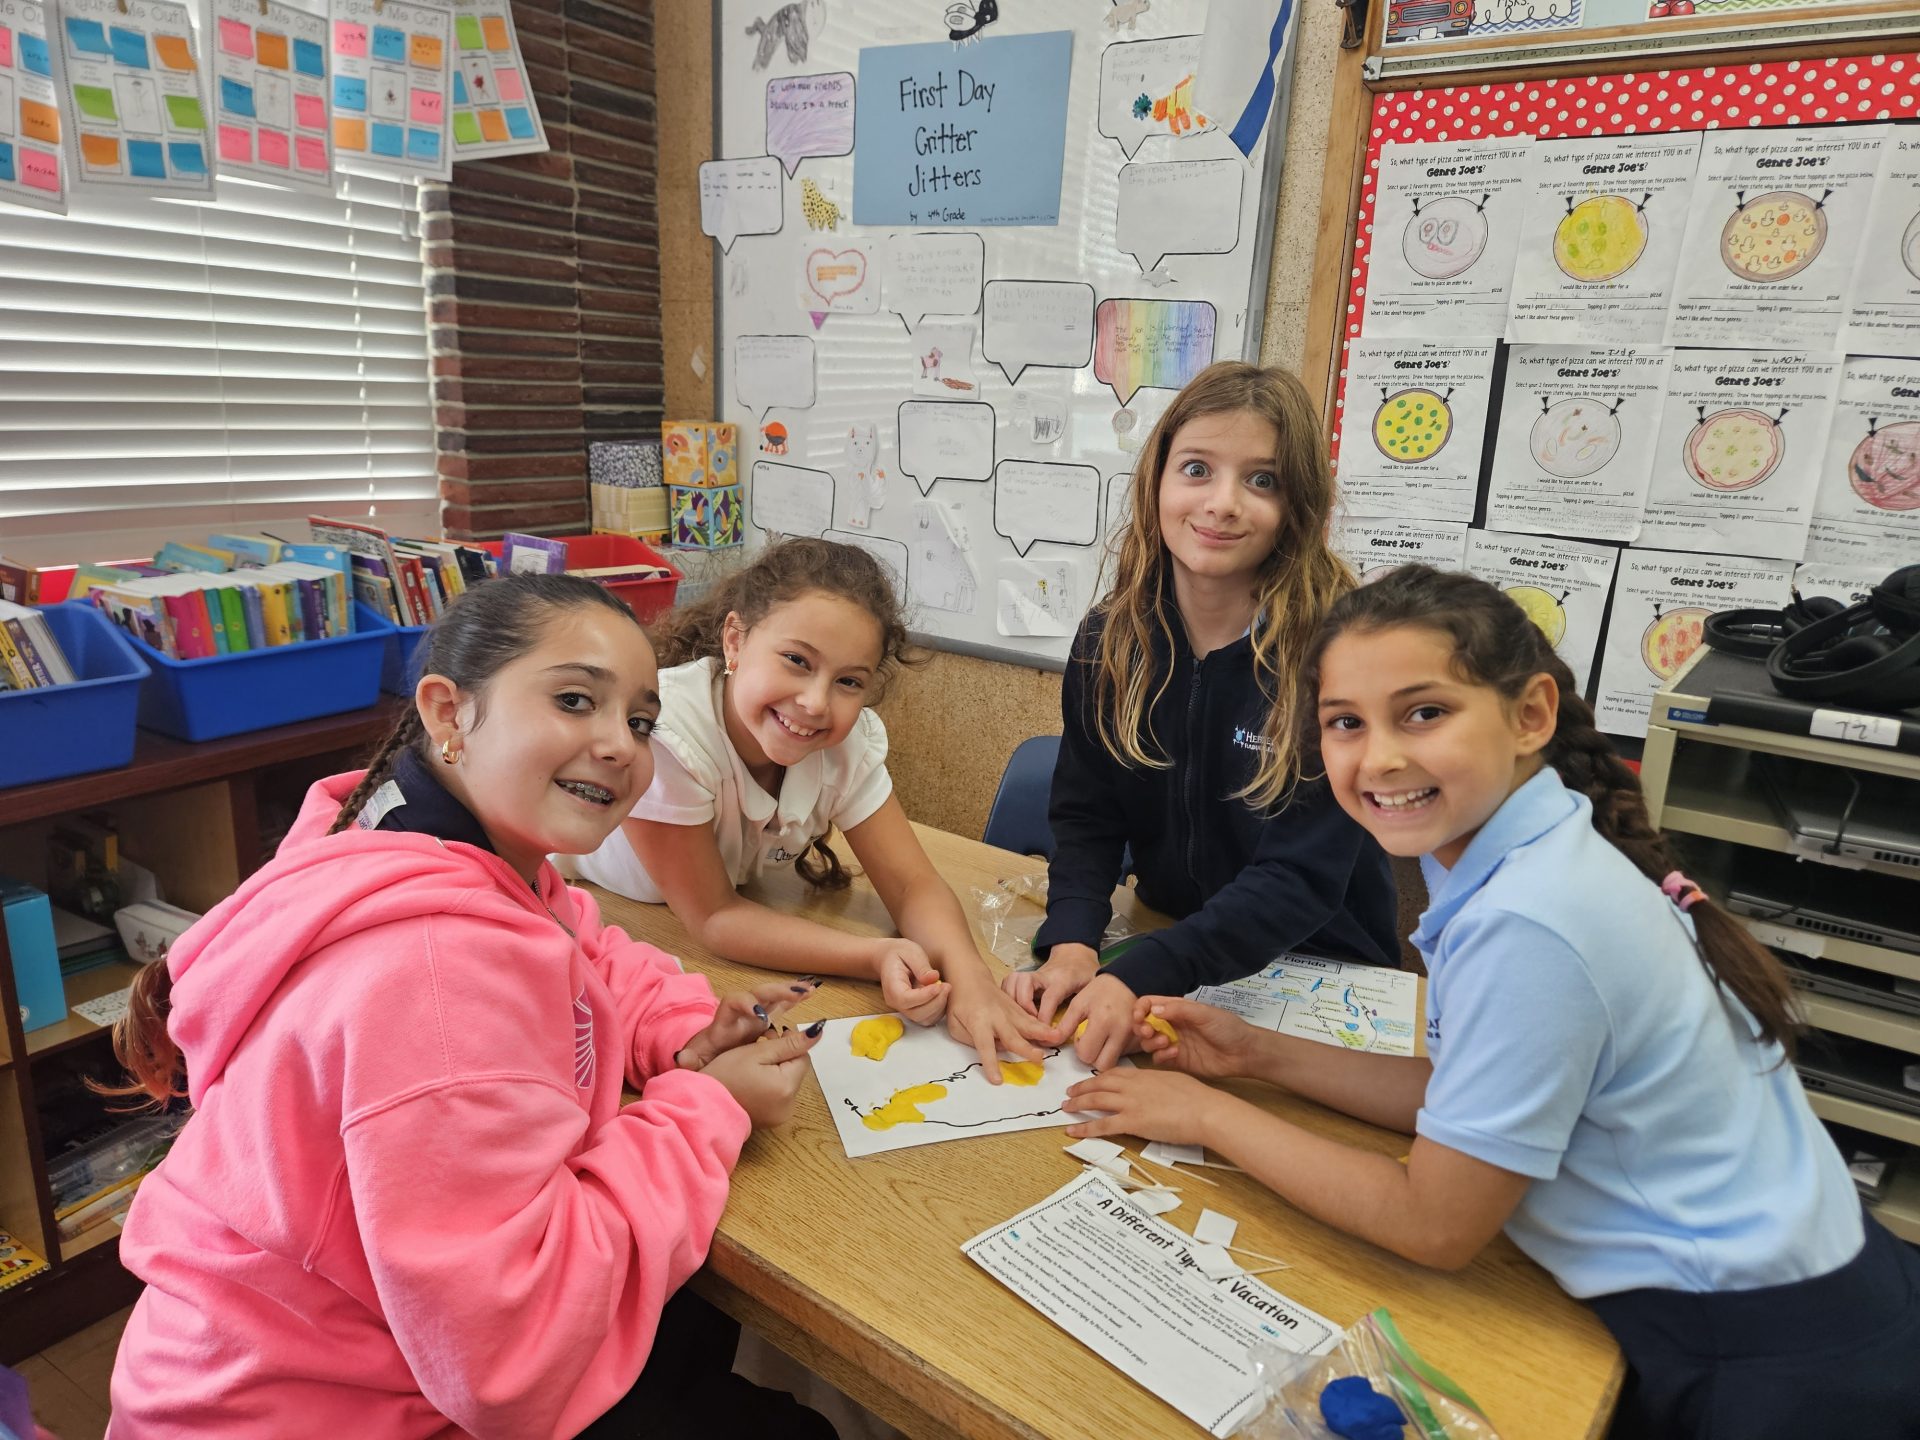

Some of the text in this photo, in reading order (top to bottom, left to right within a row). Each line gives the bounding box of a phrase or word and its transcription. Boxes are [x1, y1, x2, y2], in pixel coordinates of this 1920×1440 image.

[899, 69, 995, 113] First Day
[915, 122, 978, 156] Critter
[1713, 145, 1723, 155] So,
[1725, 145, 1743, 154] what
[1744, 145, 1759, 156] type
[1760, 144, 1770, 154] of
[1769, 146, 1788, 155] pizza
[1789, 145, 1803, 153] can
[1816, 143, 1845, 152] interest
[1847, 141, 1861, 150] YOU
[1862, 141, 1870, 149] in
[1871, 140, 1881, 149] at
[1390, 158, 1398, 167] So,
[1399, 157, 1414, 165] what
[1415, 157, 1428, 166] type
[1429, 155, 1436, 164] of
[1437, 156, 1452, 165] pizza
[1473, 151, 1497, 161] interest
[1498, 150, 1510, 159] YOU
[1511, 150, 1517, 158] in
[1518, 149, 1526, 157] at
[1543, 155, 1552, 164] So,
[1553, 154, 1569, 162] what
[1571, 153, 1585, 163] type
[1586, 152, 1594, 161] of
[1594, 152, 1611, 162] pizza
[1634, 150, 1661, 158] interest
[1663, 148, 1675, 156] YOU
[1684, 147, 1692, 155] at
[1756, 156, 1830, 168] Genre Joe's?
[1426, 164, 1486, 177] Genre Joe's?
[1582, 162, 1648, 174] Genre Joe's?
[908, 164, 981, 197] Jitters
[910, 211, 918, 224] by
[942, 207, 966, 222] Grade
[1383, 350, 1395, 359] type
[1396, 349, 1403, 357] of
[1403, 350, 1418, 359] pizza
[1438, 349, 1461, 357] interest
[1462, 349, 1473, 357] YOU
[1519, 356, 1527, 365] So,
[1546, 357, 1559, 366] type
[1560, 356, 1568, 364] of
[1568, 357, 1584, 366] pizza
[1607, 357, 1633, 365] interest
[1635, 357, 1647, 365] YOU
[1393, 360, 1450, 369] Genre Joe's?
[1673, 364, 1682, 373] So,
[1684, 364, 1701, 372] what
[1703, 364, 1718, 374] type
[1718, 364, 1727, 372] of
[1727, 365, 1745, 374] pizza
[1771, 365, 1799, 373] interest
[1801, 365, 1814, 373] YOU
[1824, 366, 1833, 374] at
[1557, 367, 1620, 378] Genre Joe's?
[1715, 376, 1785, 386] Genre Joe's?
[1370, 538, 1423, 549] Genre Joe's?
[1499, 545, 1512, 553] type
[1520, 547, 1535, 556] pizza
[1556, 552, 1580, 562] interest
[1581, 553, 1593, 563] YOU
[1593, 554, 1600, 564] in
[1600, 555, 1609, 566] at
[1509, 556, 1568, 571] Genre Joe's?
[1630, 562, 1639, 571] So,
[1659, 565, 1673, 574] type
[1674, 565, 1682, 573] of
[1682, 567, 1699, 575] pizza
[1723, 570, 1751, 579] interest
[1753, 572, 1766, 580] YOU
[1670, 576, 1737, 590] Genre Joe's?
[1284, 956, 1327, 968] Florida
[1074, 1201, 1096, 1217] Narrator
[1210, 1293, 1225, 1304] Mom
[1096, 1198, 1113, 1210] A
[1109, 1206, 1175, 1249] Different
[1230, 1281, 1299, 1330] Vacation
